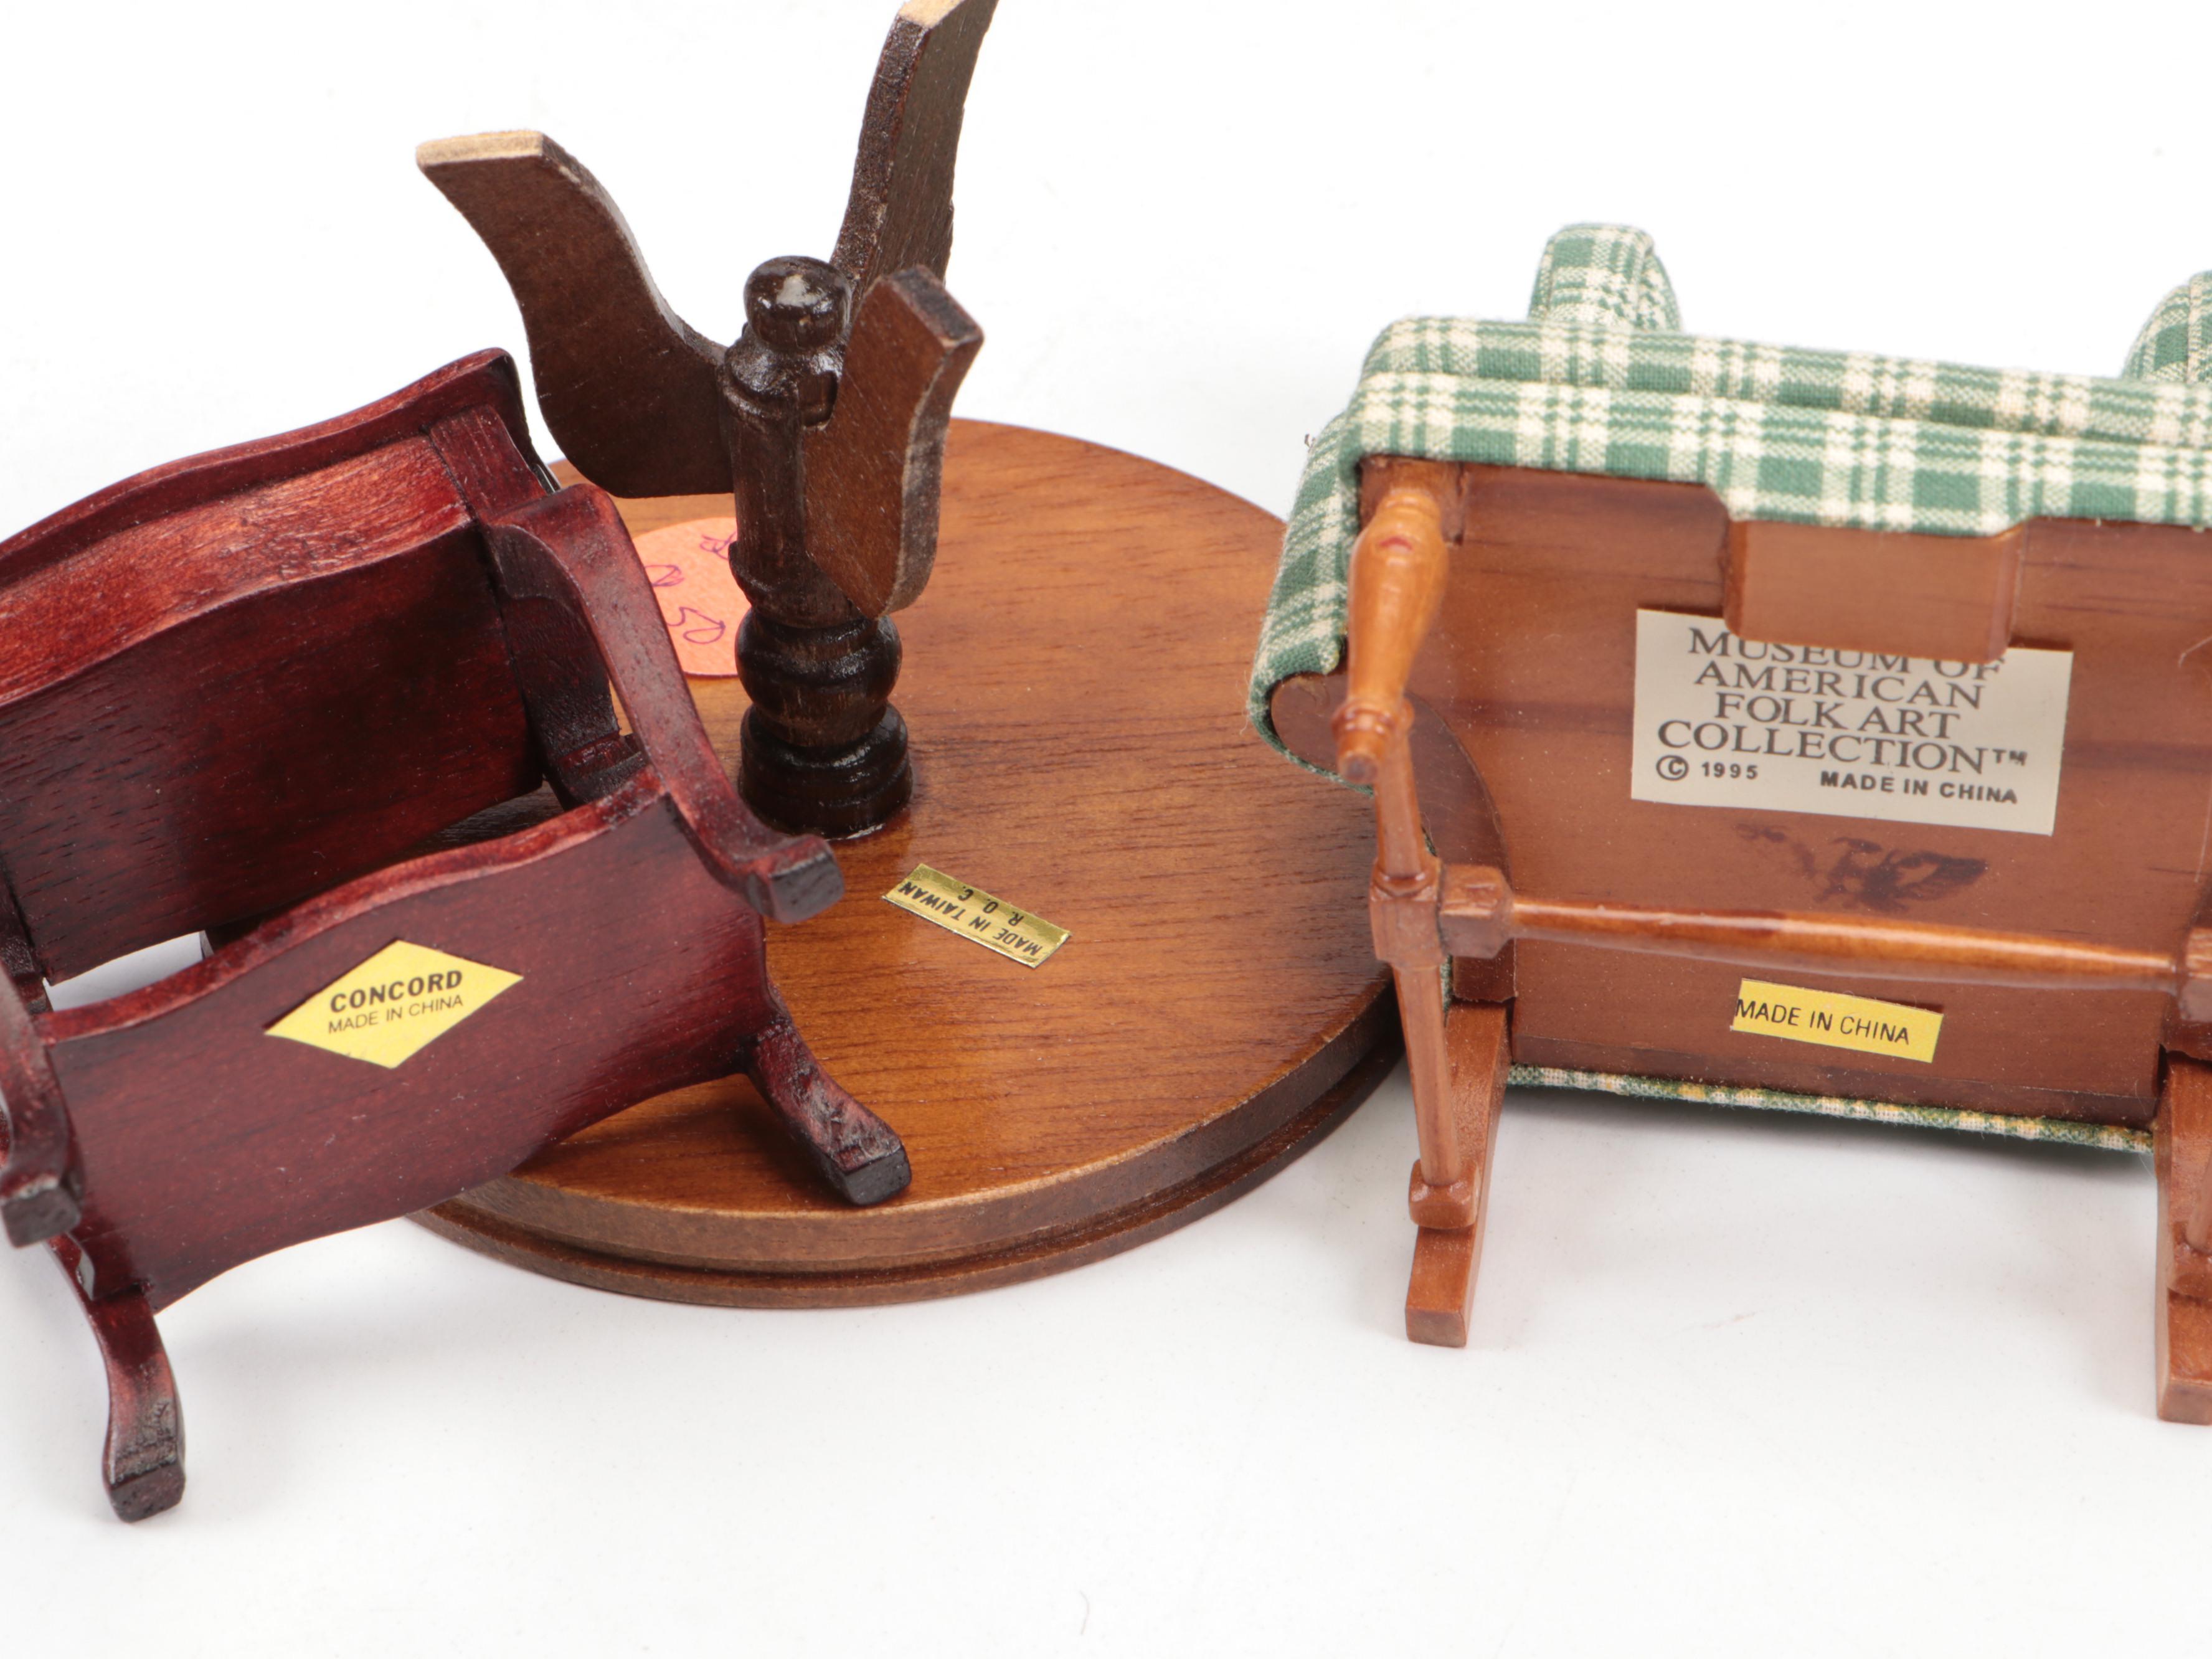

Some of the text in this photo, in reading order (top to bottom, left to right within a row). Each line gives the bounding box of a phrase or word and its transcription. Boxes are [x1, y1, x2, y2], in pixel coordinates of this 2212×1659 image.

[1688, 627, 2005, 681] MUSEUM OF
[1693, 660, 1986, 710] AMERICAN
[1715, 691, 1961, 739] FOLK ART
[1701, 762, 1759, 780] 1995
[1820, 770, 2018, 805] MADE IN CHINA
[897, 881, 1043, 957] MADE IN TAIWAN
[328, 994, 464, 1034] MADE IN CHINA
[329, 970, 463, 1014] CONCORD
[1735, 998, 1910, 1046] MADE IN CHINA
